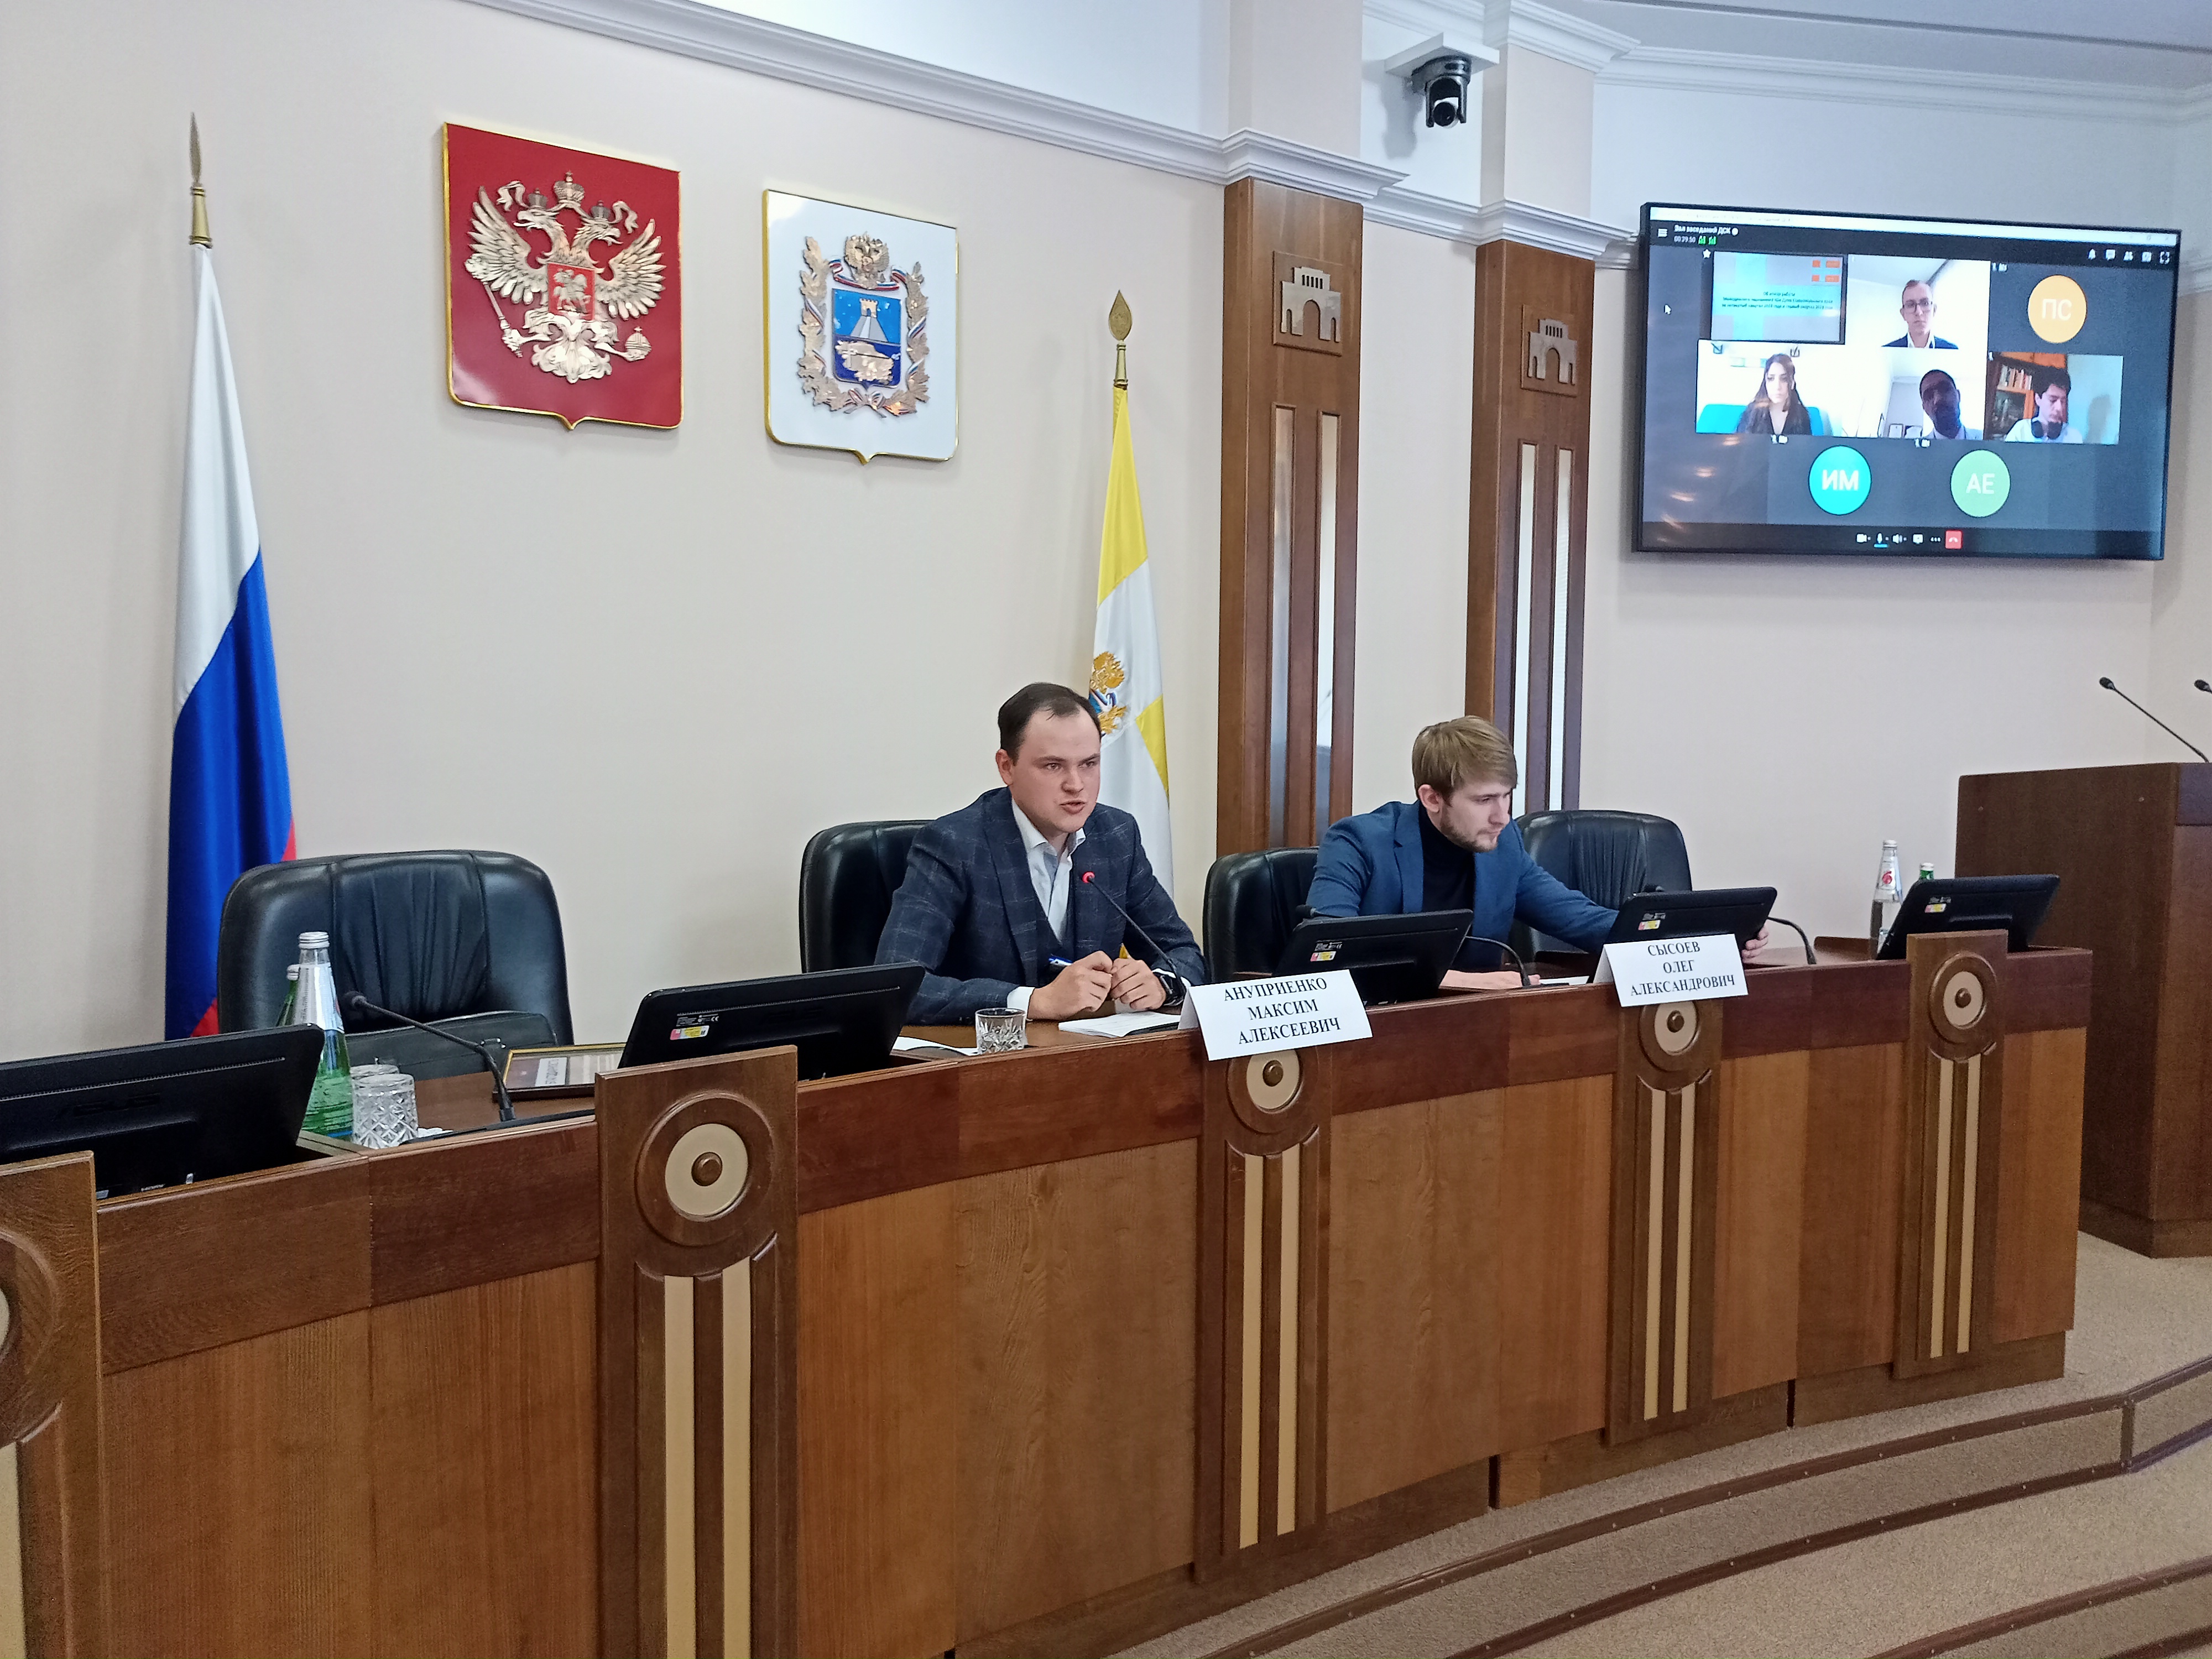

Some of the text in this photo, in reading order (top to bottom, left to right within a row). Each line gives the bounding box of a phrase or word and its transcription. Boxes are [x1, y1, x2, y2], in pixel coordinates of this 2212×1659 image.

[2042, 298, 2073, 321] ПС
[1821, 469, 1859, 491] ИМ
[1965, 473, 1995, 494] АЕ
[1647, 941, 1700, 956] СЫСОЕВ
[1663, 959, 1695, 974] ОЛЕГ
[1224, 977, 1327, 1001] АНУПРИЕНКО
[1631, 974, 1735, 997] АЛЕКСАНДРОВИЧ
[1246, 999, 1319, 1021] МАКСИМ
[1239, 1017, 1342, 1045] АЛЕКСЕЕВИЧ
